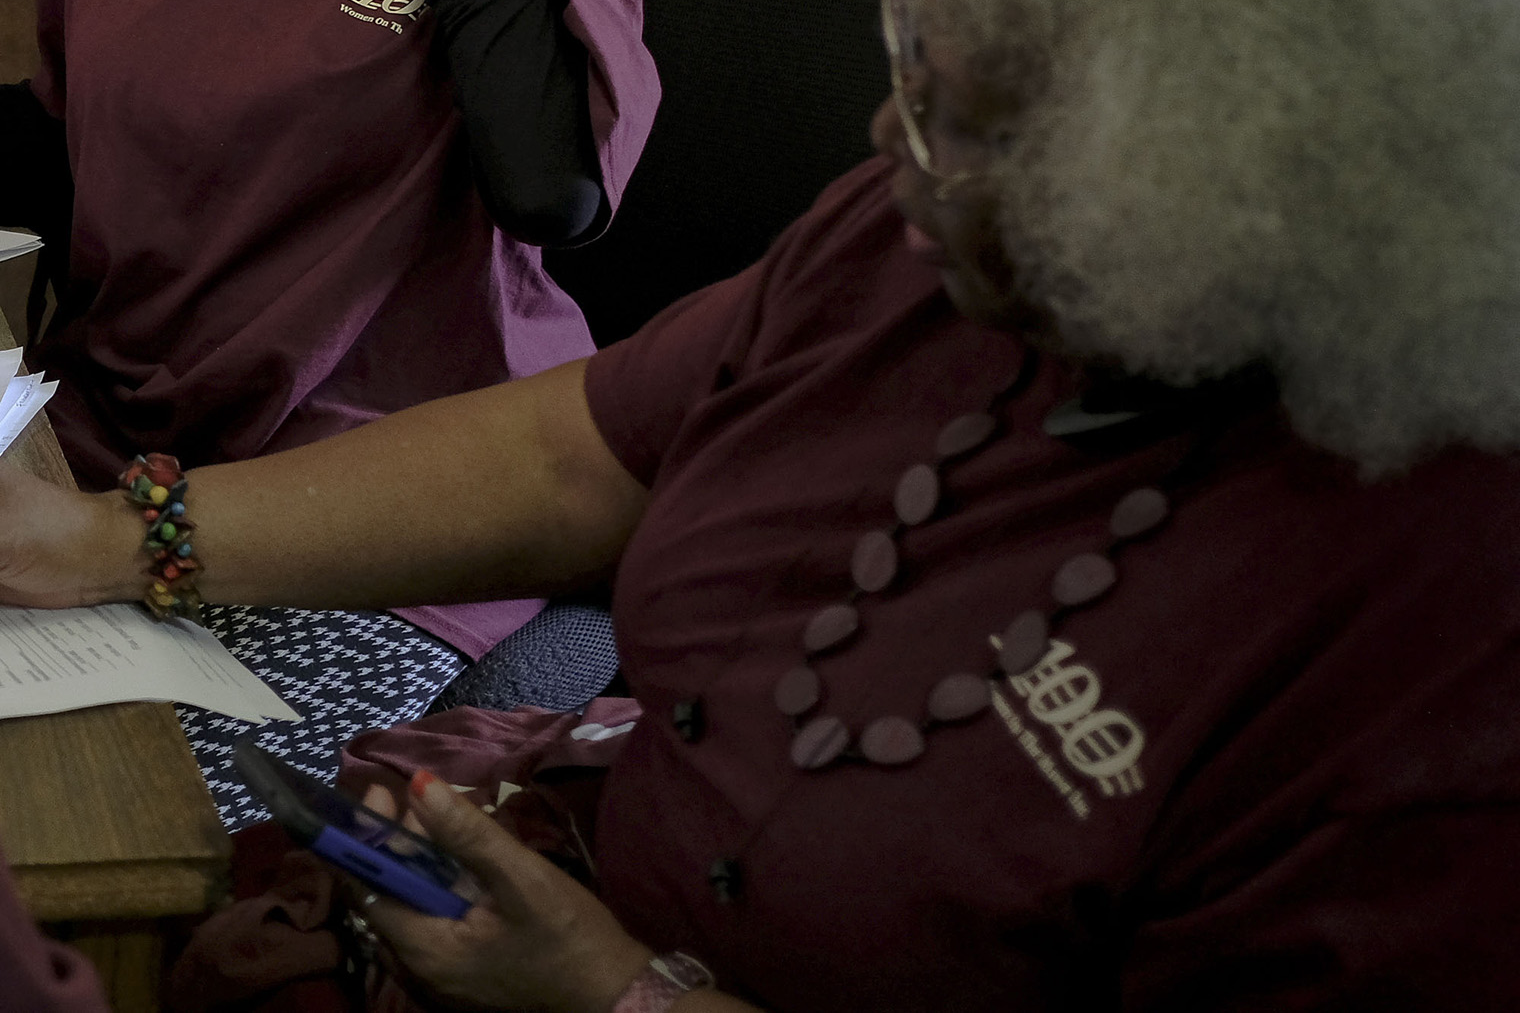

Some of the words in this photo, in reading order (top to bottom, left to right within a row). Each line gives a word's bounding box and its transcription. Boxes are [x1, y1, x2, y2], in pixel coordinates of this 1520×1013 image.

[339, 3, 374, 23] Women
[375, 16, 389, 28] On
[389, 21, 404, 35] Th
[1009, 638, 1146, 780] 100
